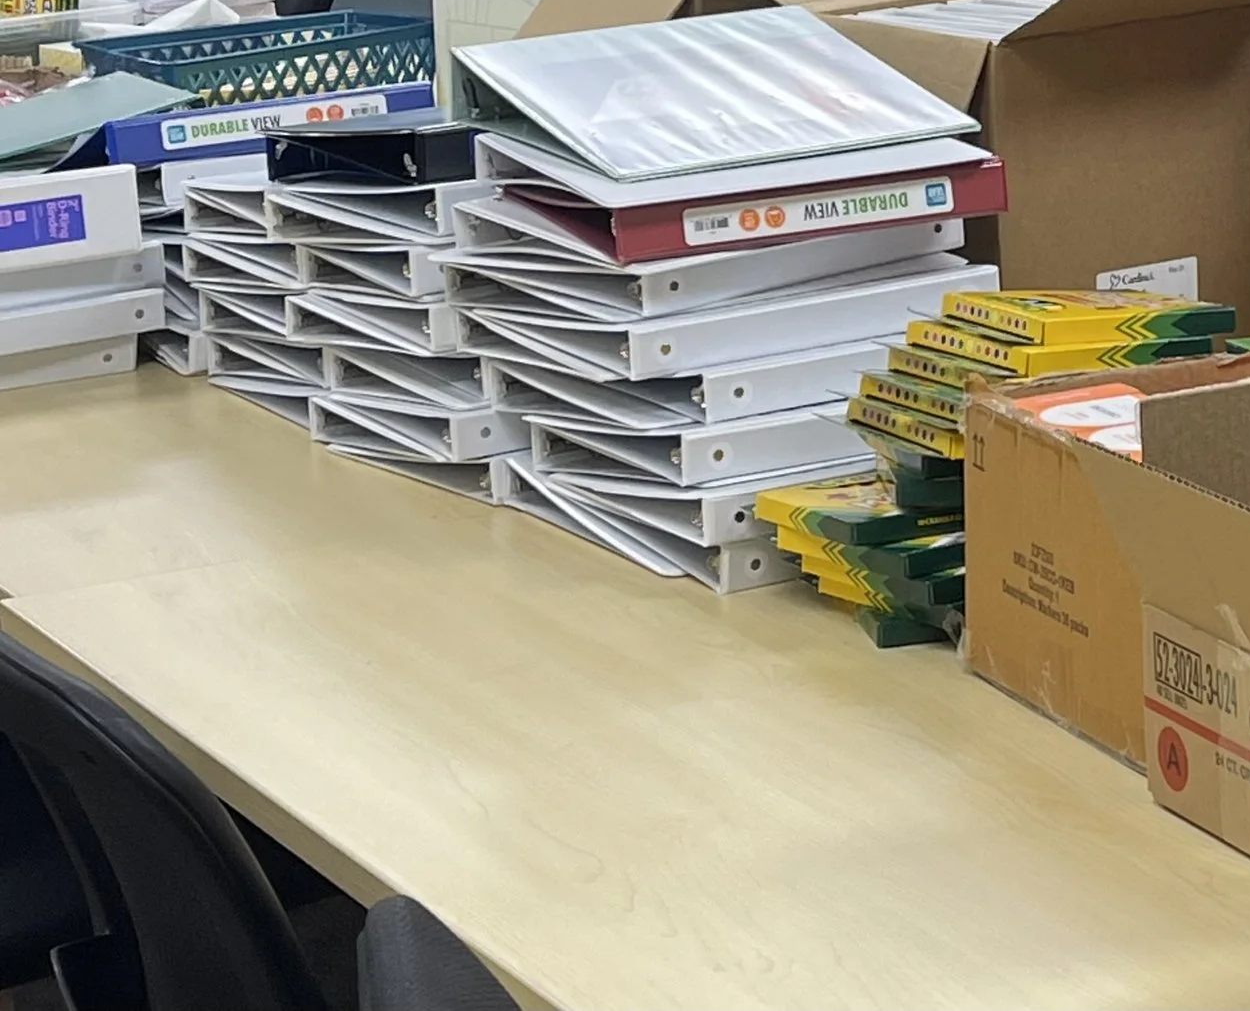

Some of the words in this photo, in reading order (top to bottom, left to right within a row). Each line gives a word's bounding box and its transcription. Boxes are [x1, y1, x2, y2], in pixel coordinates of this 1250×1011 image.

[190, 118, 250, 139] DURABLE
[250, 114, 281, 132] VIEW
[803, 198, 840, 222] VIEW
[842, 191, 908, 216] DURABLE
[1166, 742, 1182, 777] A
